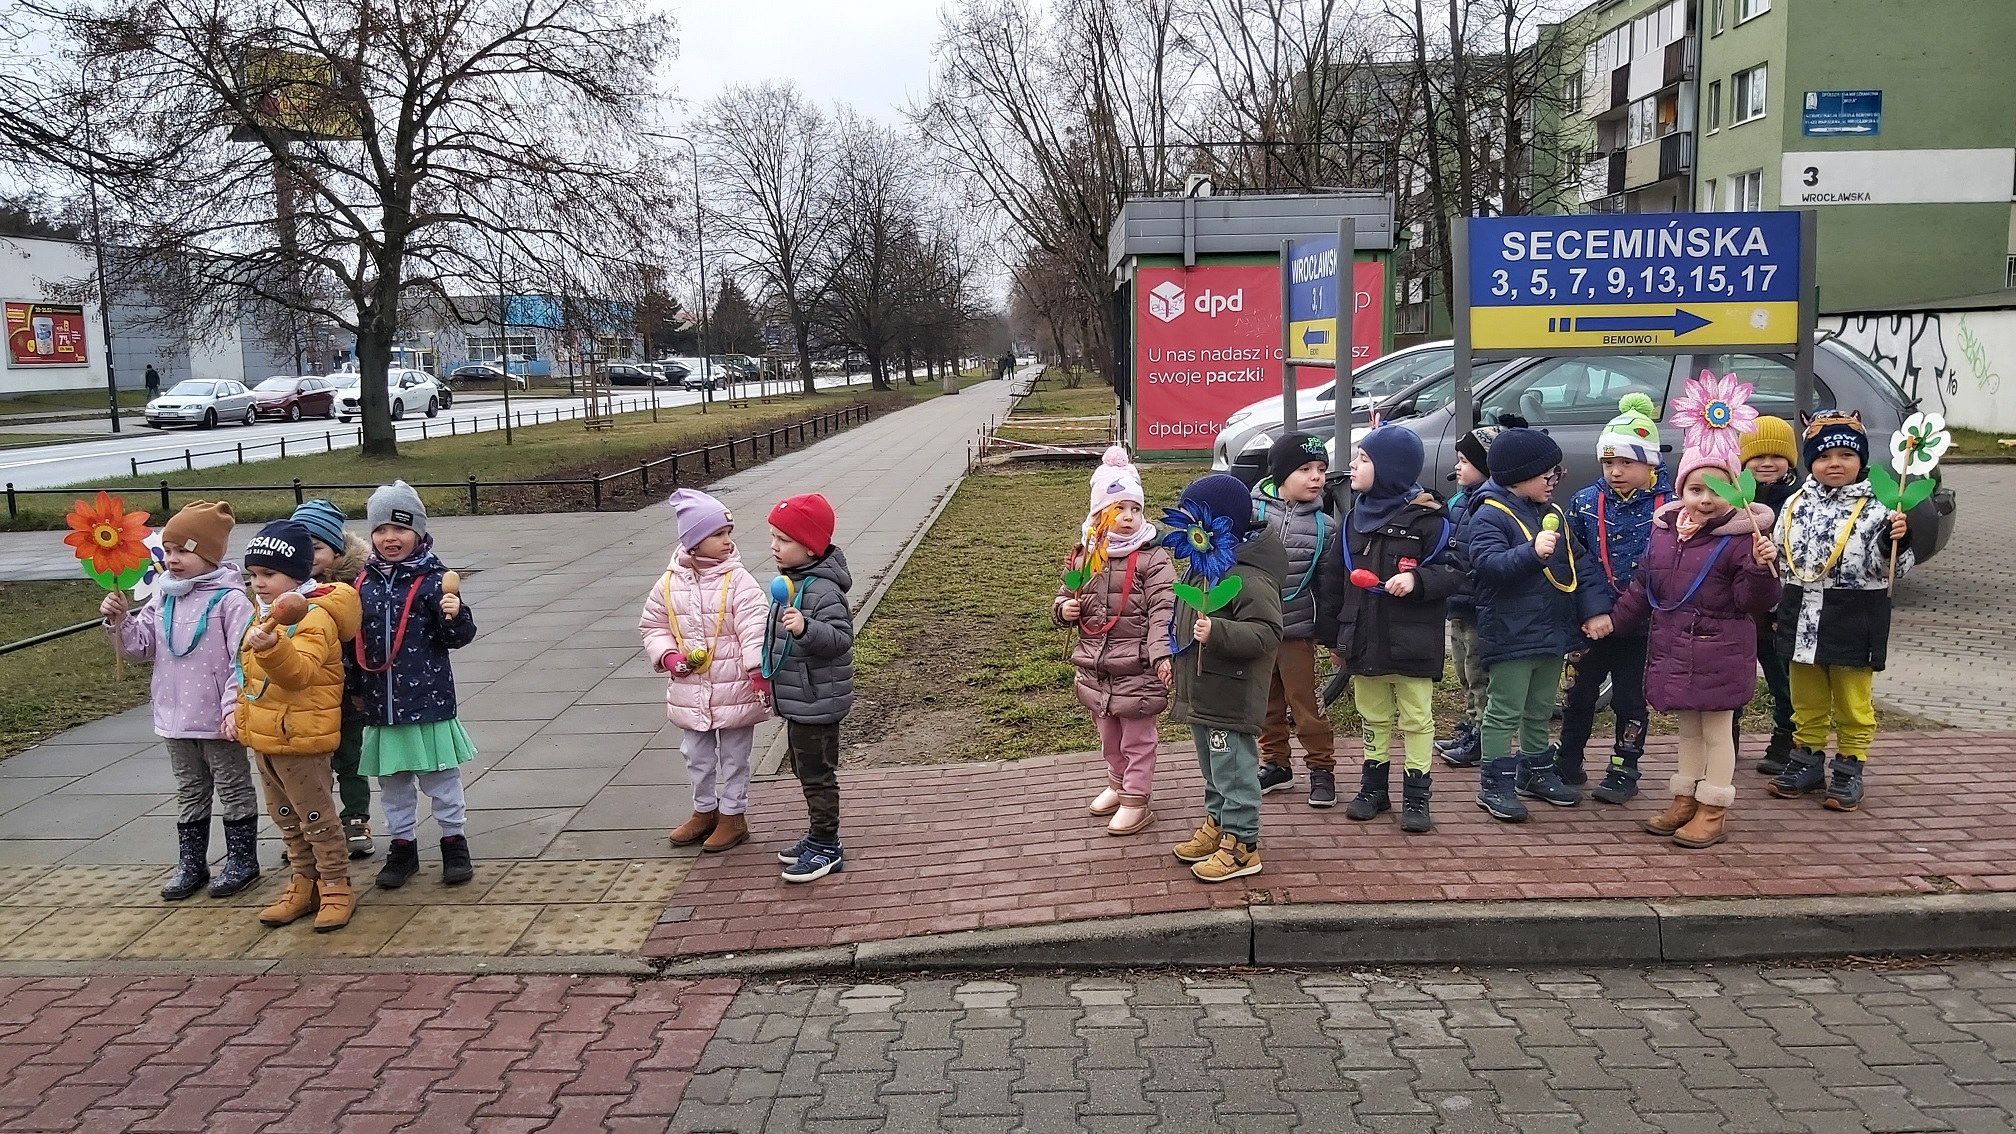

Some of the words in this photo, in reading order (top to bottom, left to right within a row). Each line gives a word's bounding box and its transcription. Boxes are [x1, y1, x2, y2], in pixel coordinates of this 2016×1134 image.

[1803, 166, 1819, 187] 3
[1801, 192, 1871, 203] WROCŁAWSKA
[1501, 221, 1769, 261] SECEMIŃSKA
[1291, 248, 1338, 285] WROCŁAWSK
[1194, 288, 1244, 318] dpd
[1603, 334, 1652, 345] BEMOWO
[1148, 348, 1162, 362] U
[1166, 349, 1197, 362] nas
[1201, 345, 1261, 362] nadasz
[1264, 345, 1270, 360] i
[1149, 369, 1202, 386] swoje
[1206, 367, 1265, 386] paczki!
[1817, 440, 1860, 452] PATROL
[1823, 434, 1857, 443] PAW
[253, 549, 274, 557] SAFARI
